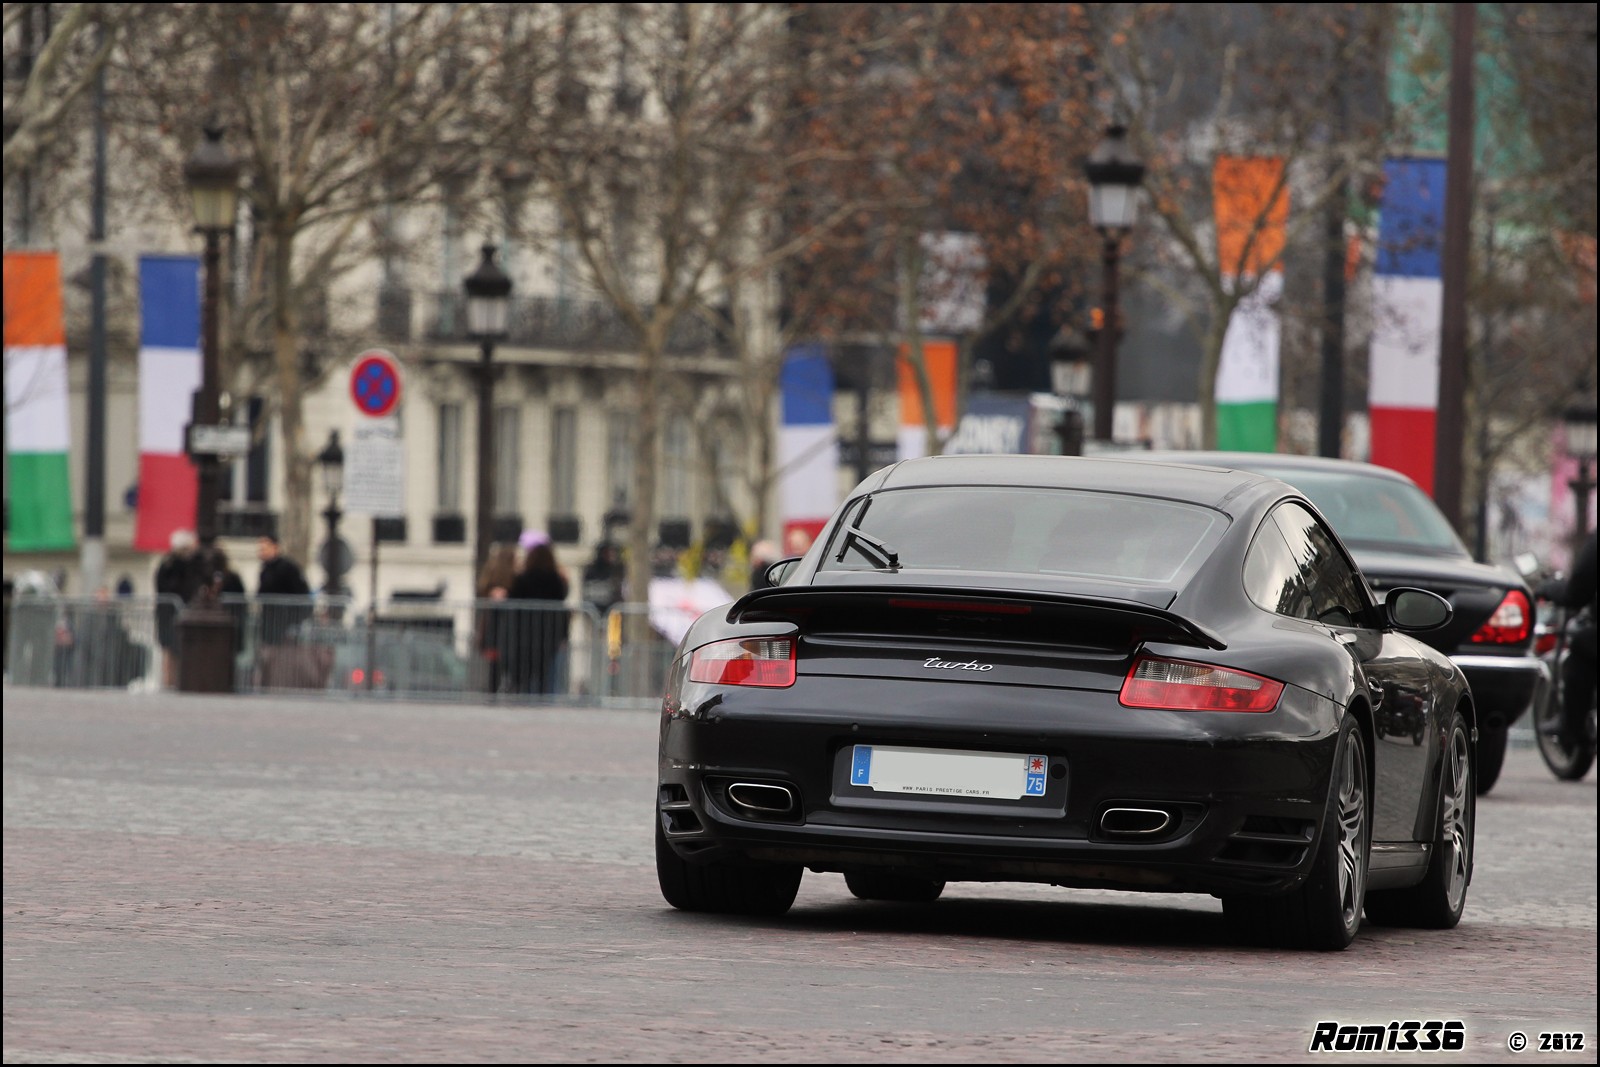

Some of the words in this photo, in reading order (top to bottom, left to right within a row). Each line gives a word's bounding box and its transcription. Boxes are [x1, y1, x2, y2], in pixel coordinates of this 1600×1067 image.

[923, 656, 993, 671] turbo
[858, 769, 864, 778] F
[1028, 777, 1043, 791] 75
